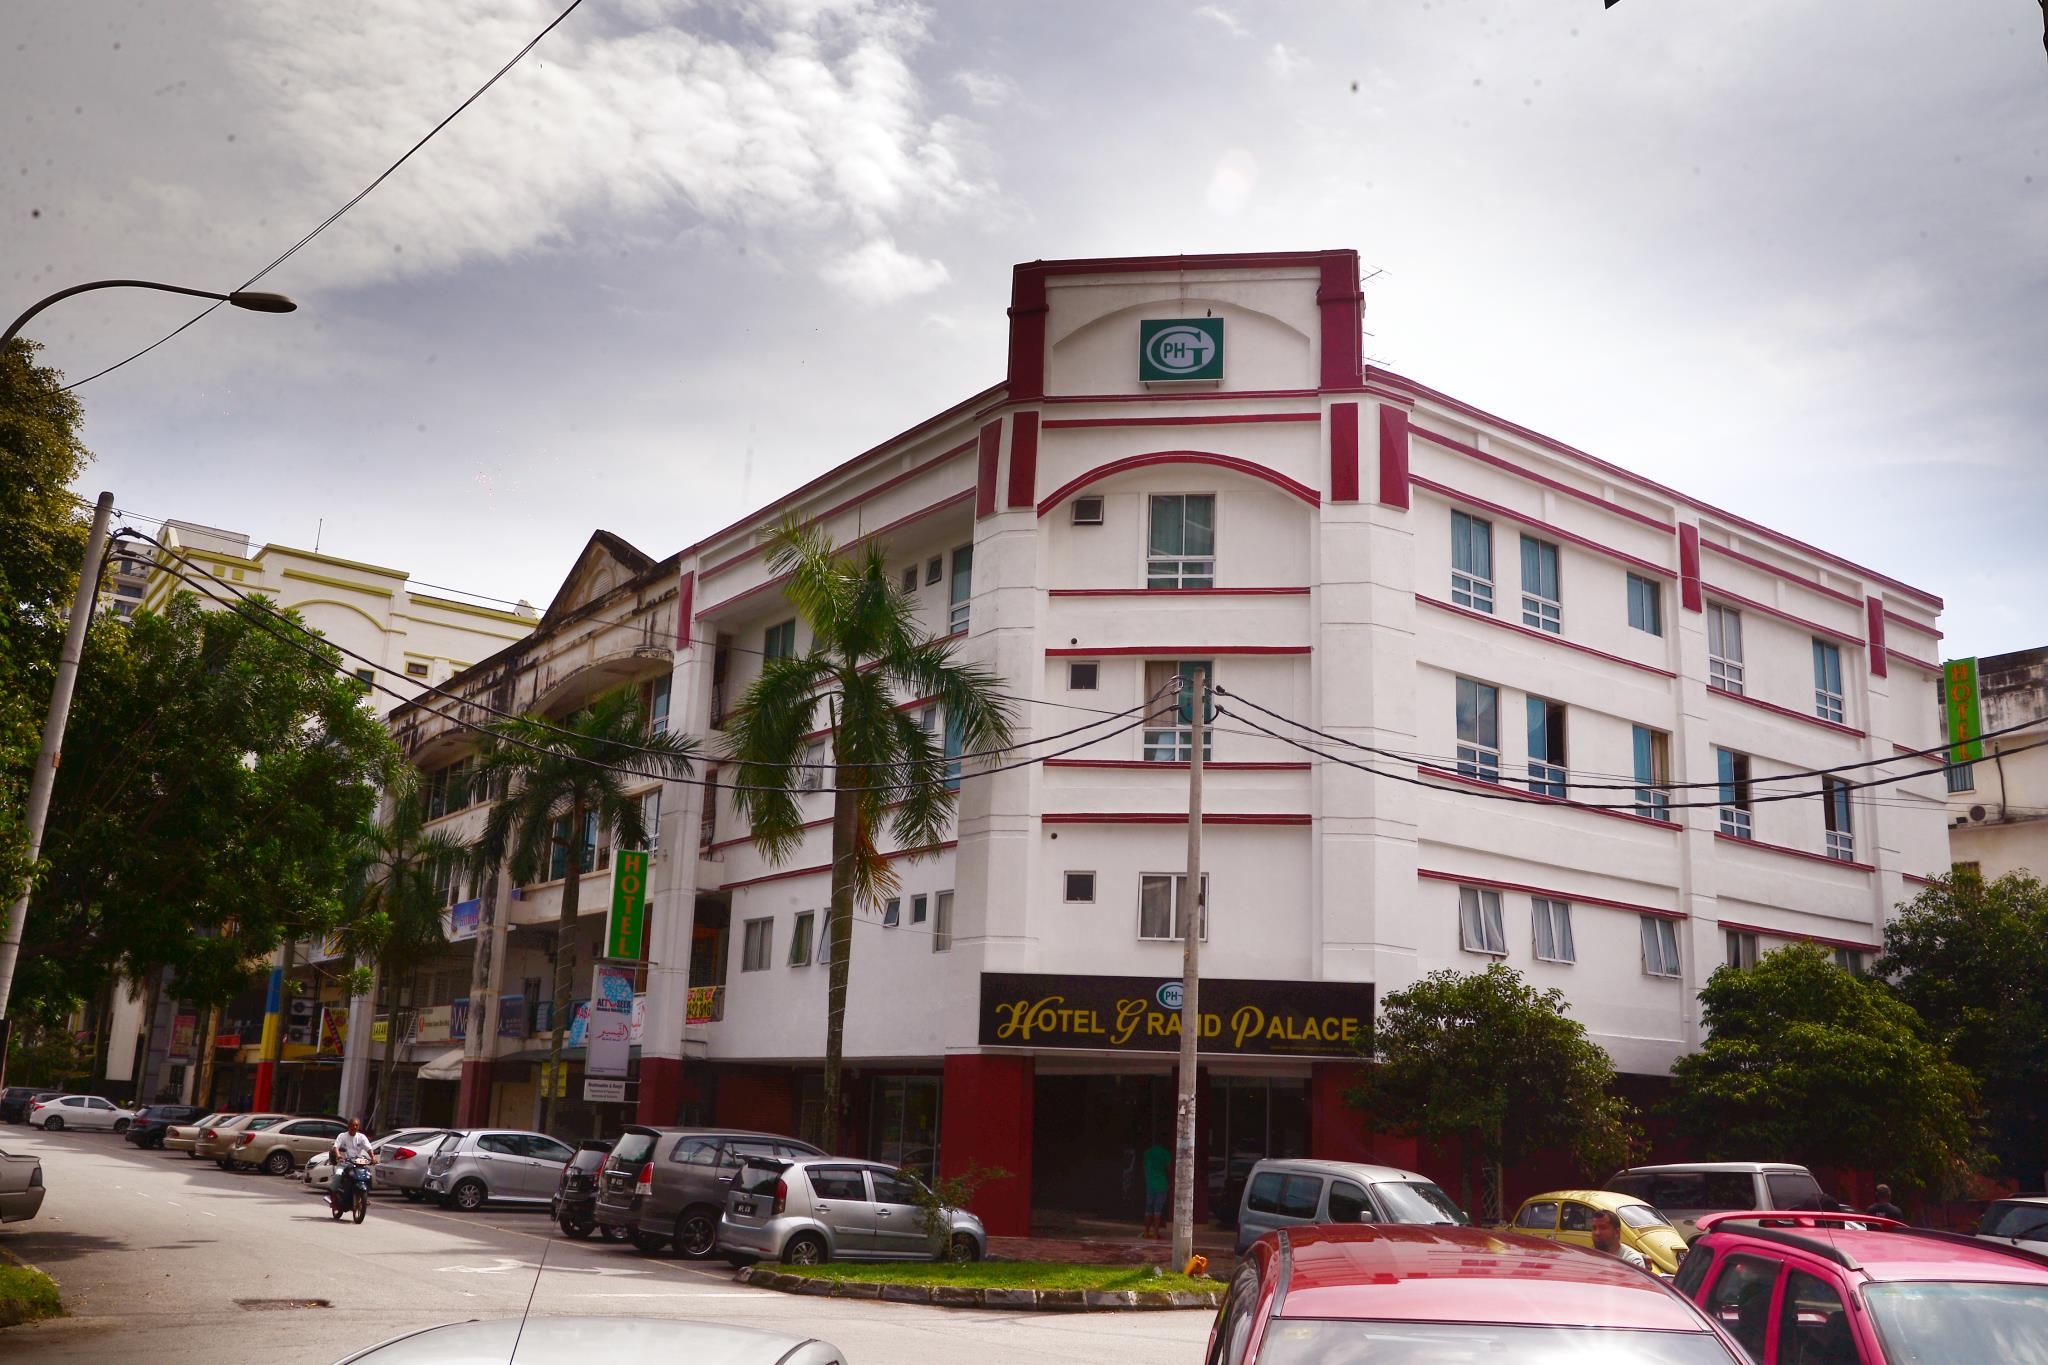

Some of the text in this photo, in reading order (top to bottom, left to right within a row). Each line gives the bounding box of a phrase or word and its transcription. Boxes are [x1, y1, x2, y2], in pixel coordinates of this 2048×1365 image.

[1951, 663, 1972, 761] HOTEL
[618, 853, 641, 956] HOTEL
[995, 996, 1105, 1041] HOTEL
[1231, 1005, 1358, 1048] PALACE
